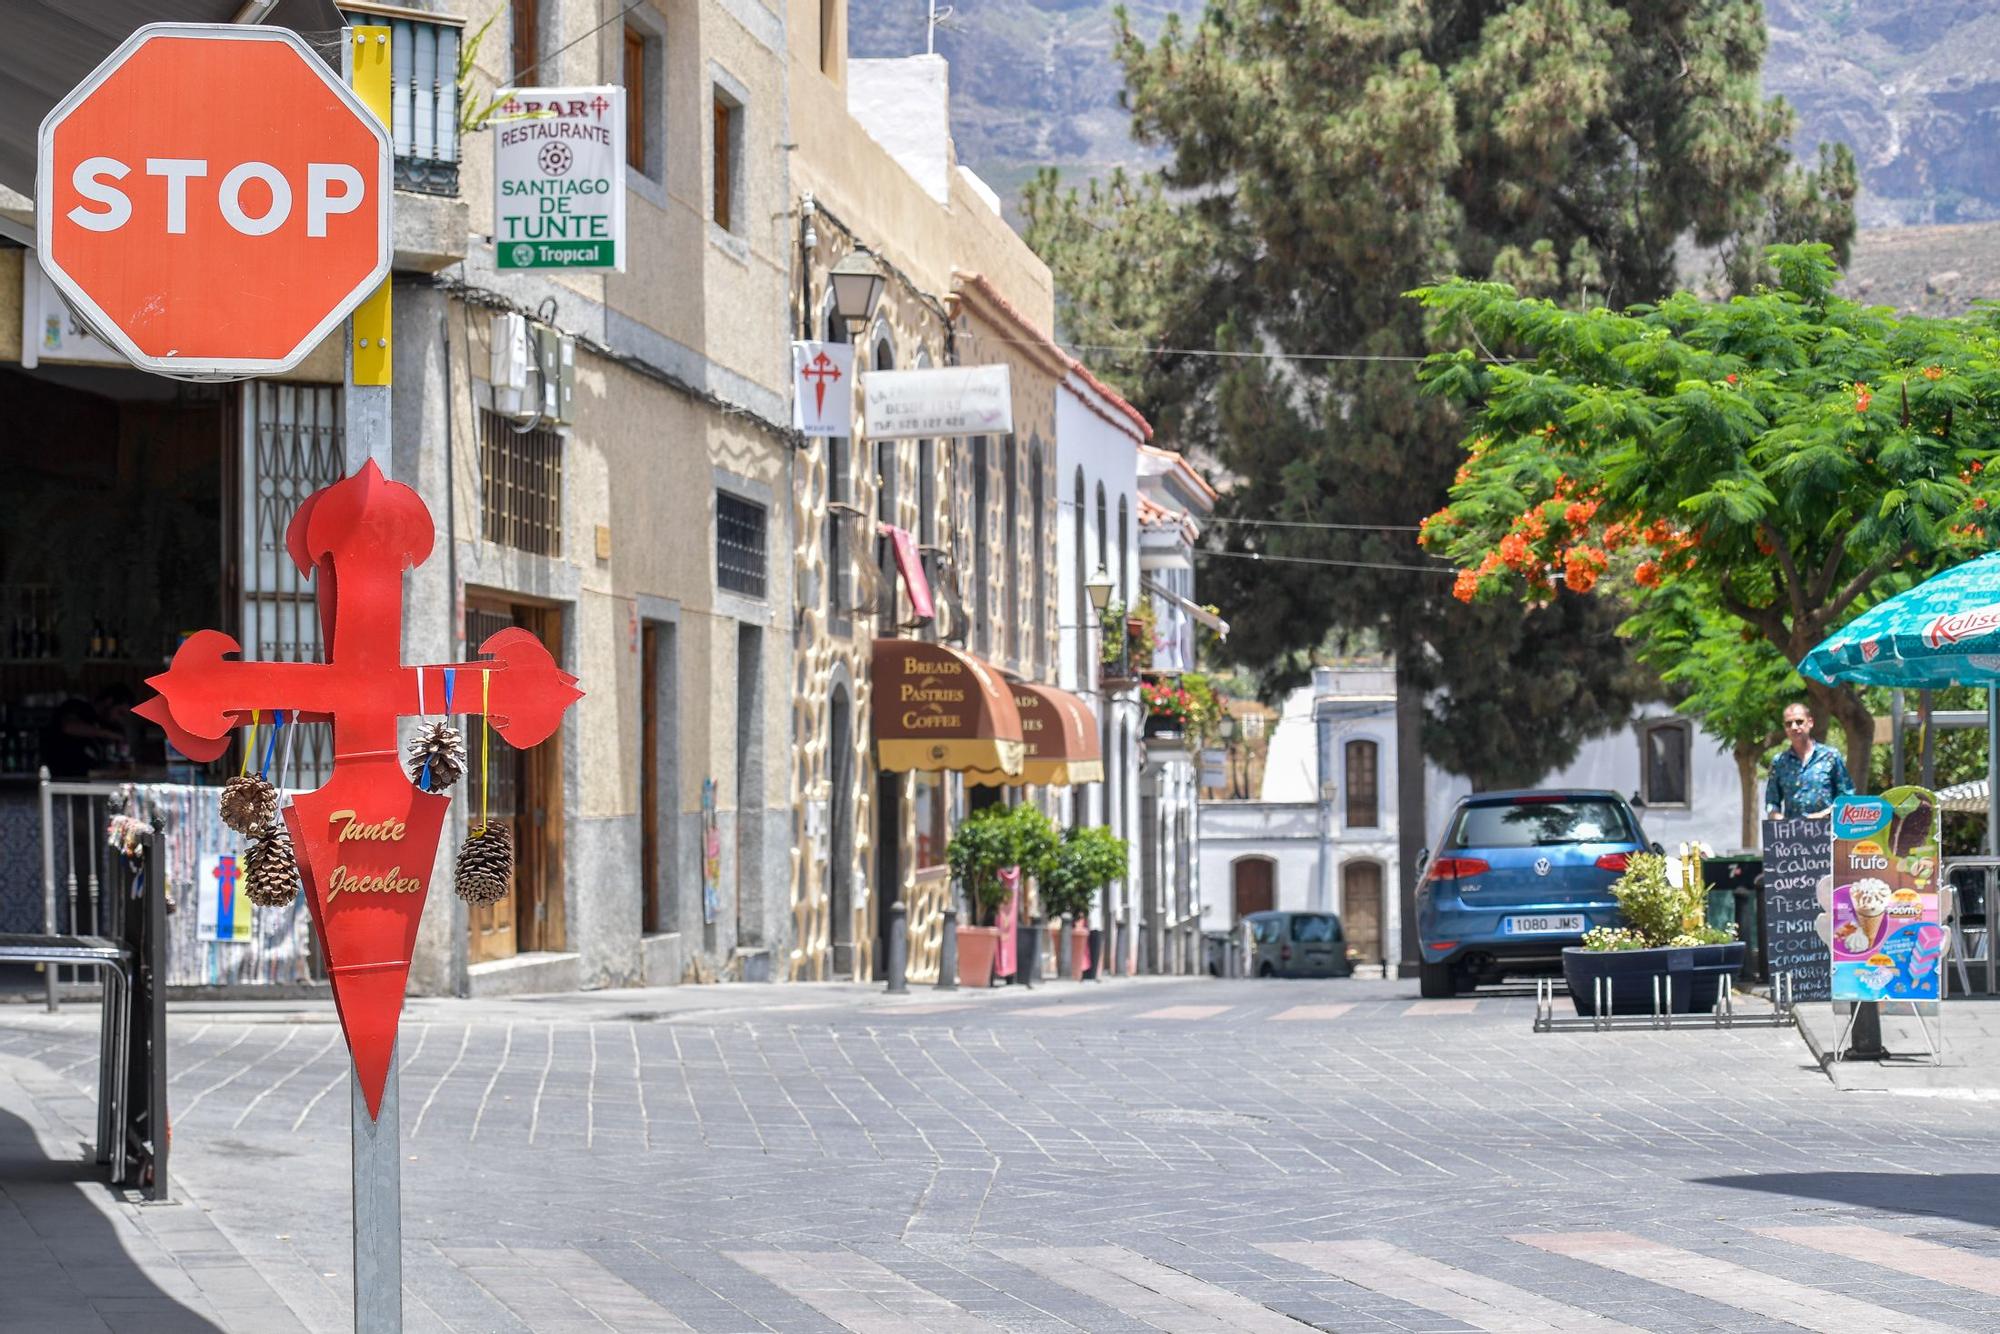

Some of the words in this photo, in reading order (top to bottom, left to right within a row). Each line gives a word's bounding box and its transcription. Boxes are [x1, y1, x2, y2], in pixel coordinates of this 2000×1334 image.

[524, 100, 589, 118] BAR
[502, 122, 611, 148] RESTAURANTE
[66, 156, 365, 238] STOP
[502, 179, 610, 196] SANTIAGO
[540, 197, 572, 214] DE
[503, 215, 609, 239] TUNTE
[538, 245, 599, 264] Tropical
[904, 656, 962, 675] BREADS
[901, 684, 964, 702] PASTRIES
[902, 711, 961, 729] COFFEE
[1841, 802, 1881, 824] Kalise
[329, 809, 406, 843] Tunte
[1848, 854, 1888, 870] Trufo
[326, 864, 421, 904] Jacobeo
[1517, 919, 1549, 932] 1080
[1555, 917, 1580, 930] JMS
